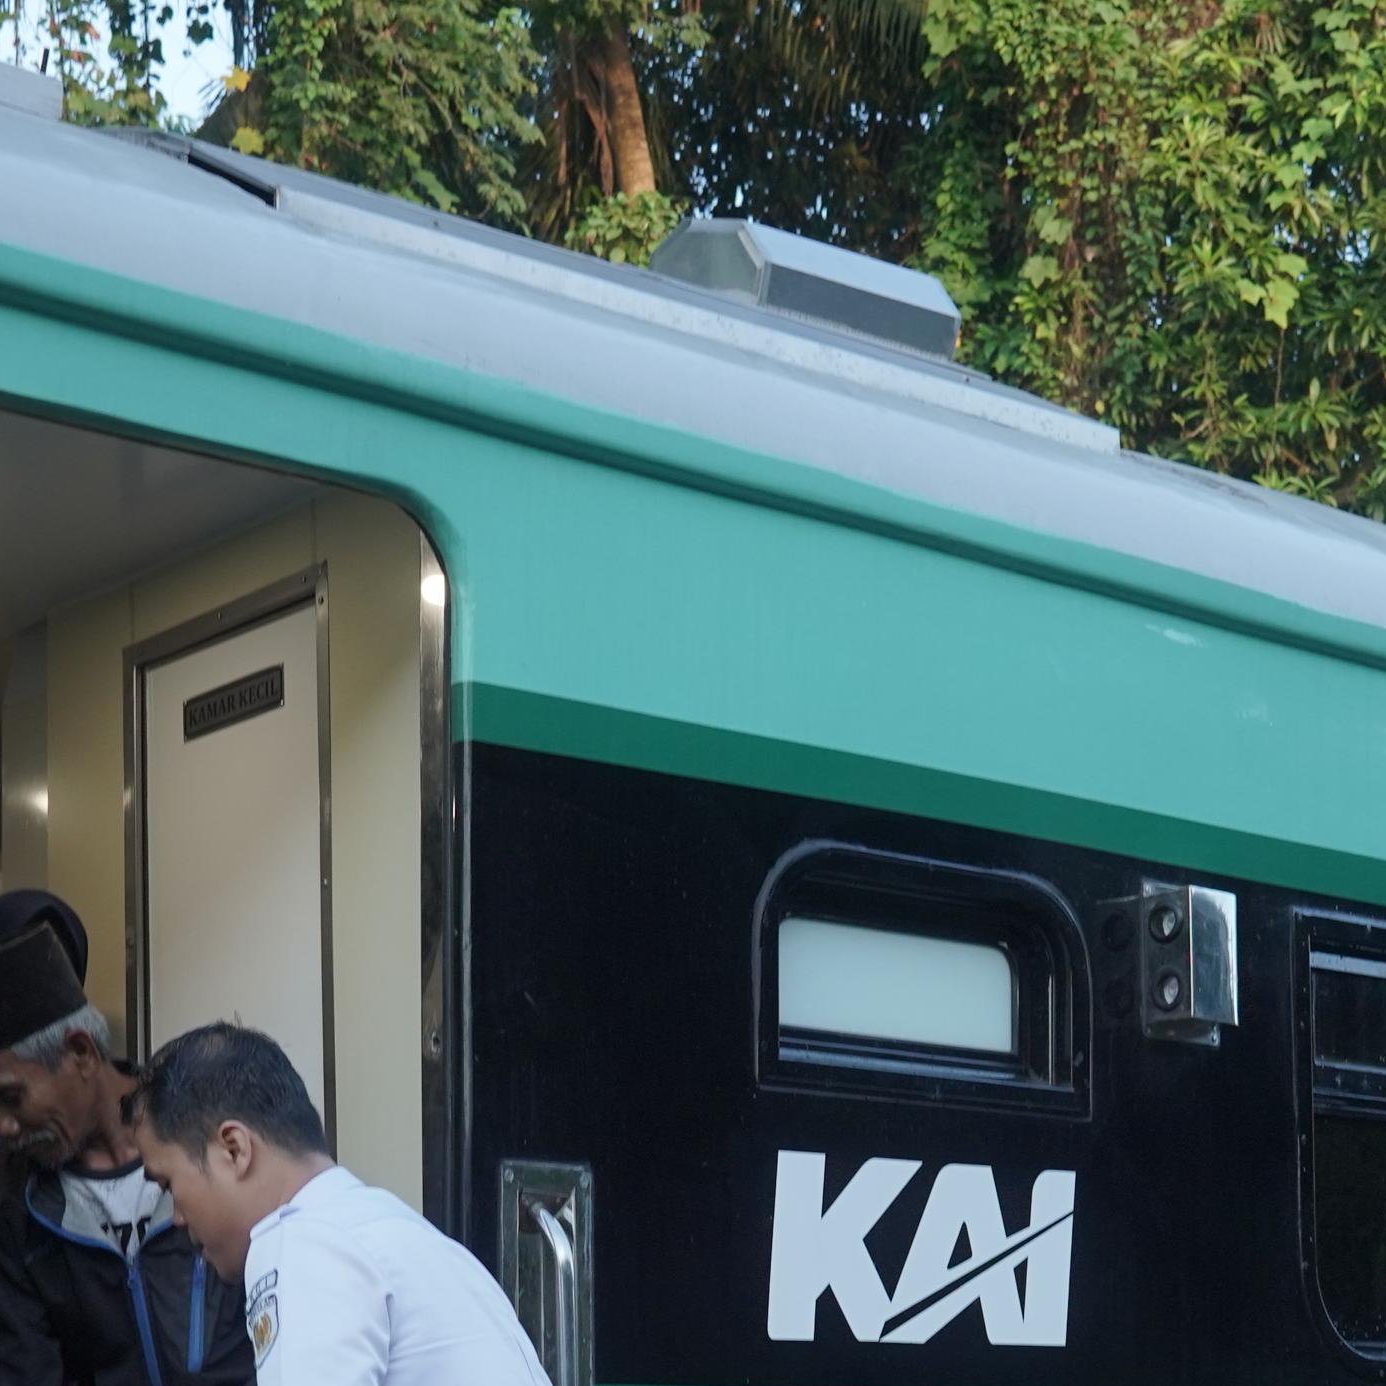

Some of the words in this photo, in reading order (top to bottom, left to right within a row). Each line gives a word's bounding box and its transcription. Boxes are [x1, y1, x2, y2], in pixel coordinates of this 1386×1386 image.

[188, 694, 236, 729] KAMAR
[239, 677, 279, 709] KECIL
[767, 1149, 1076, 1347] KAI
